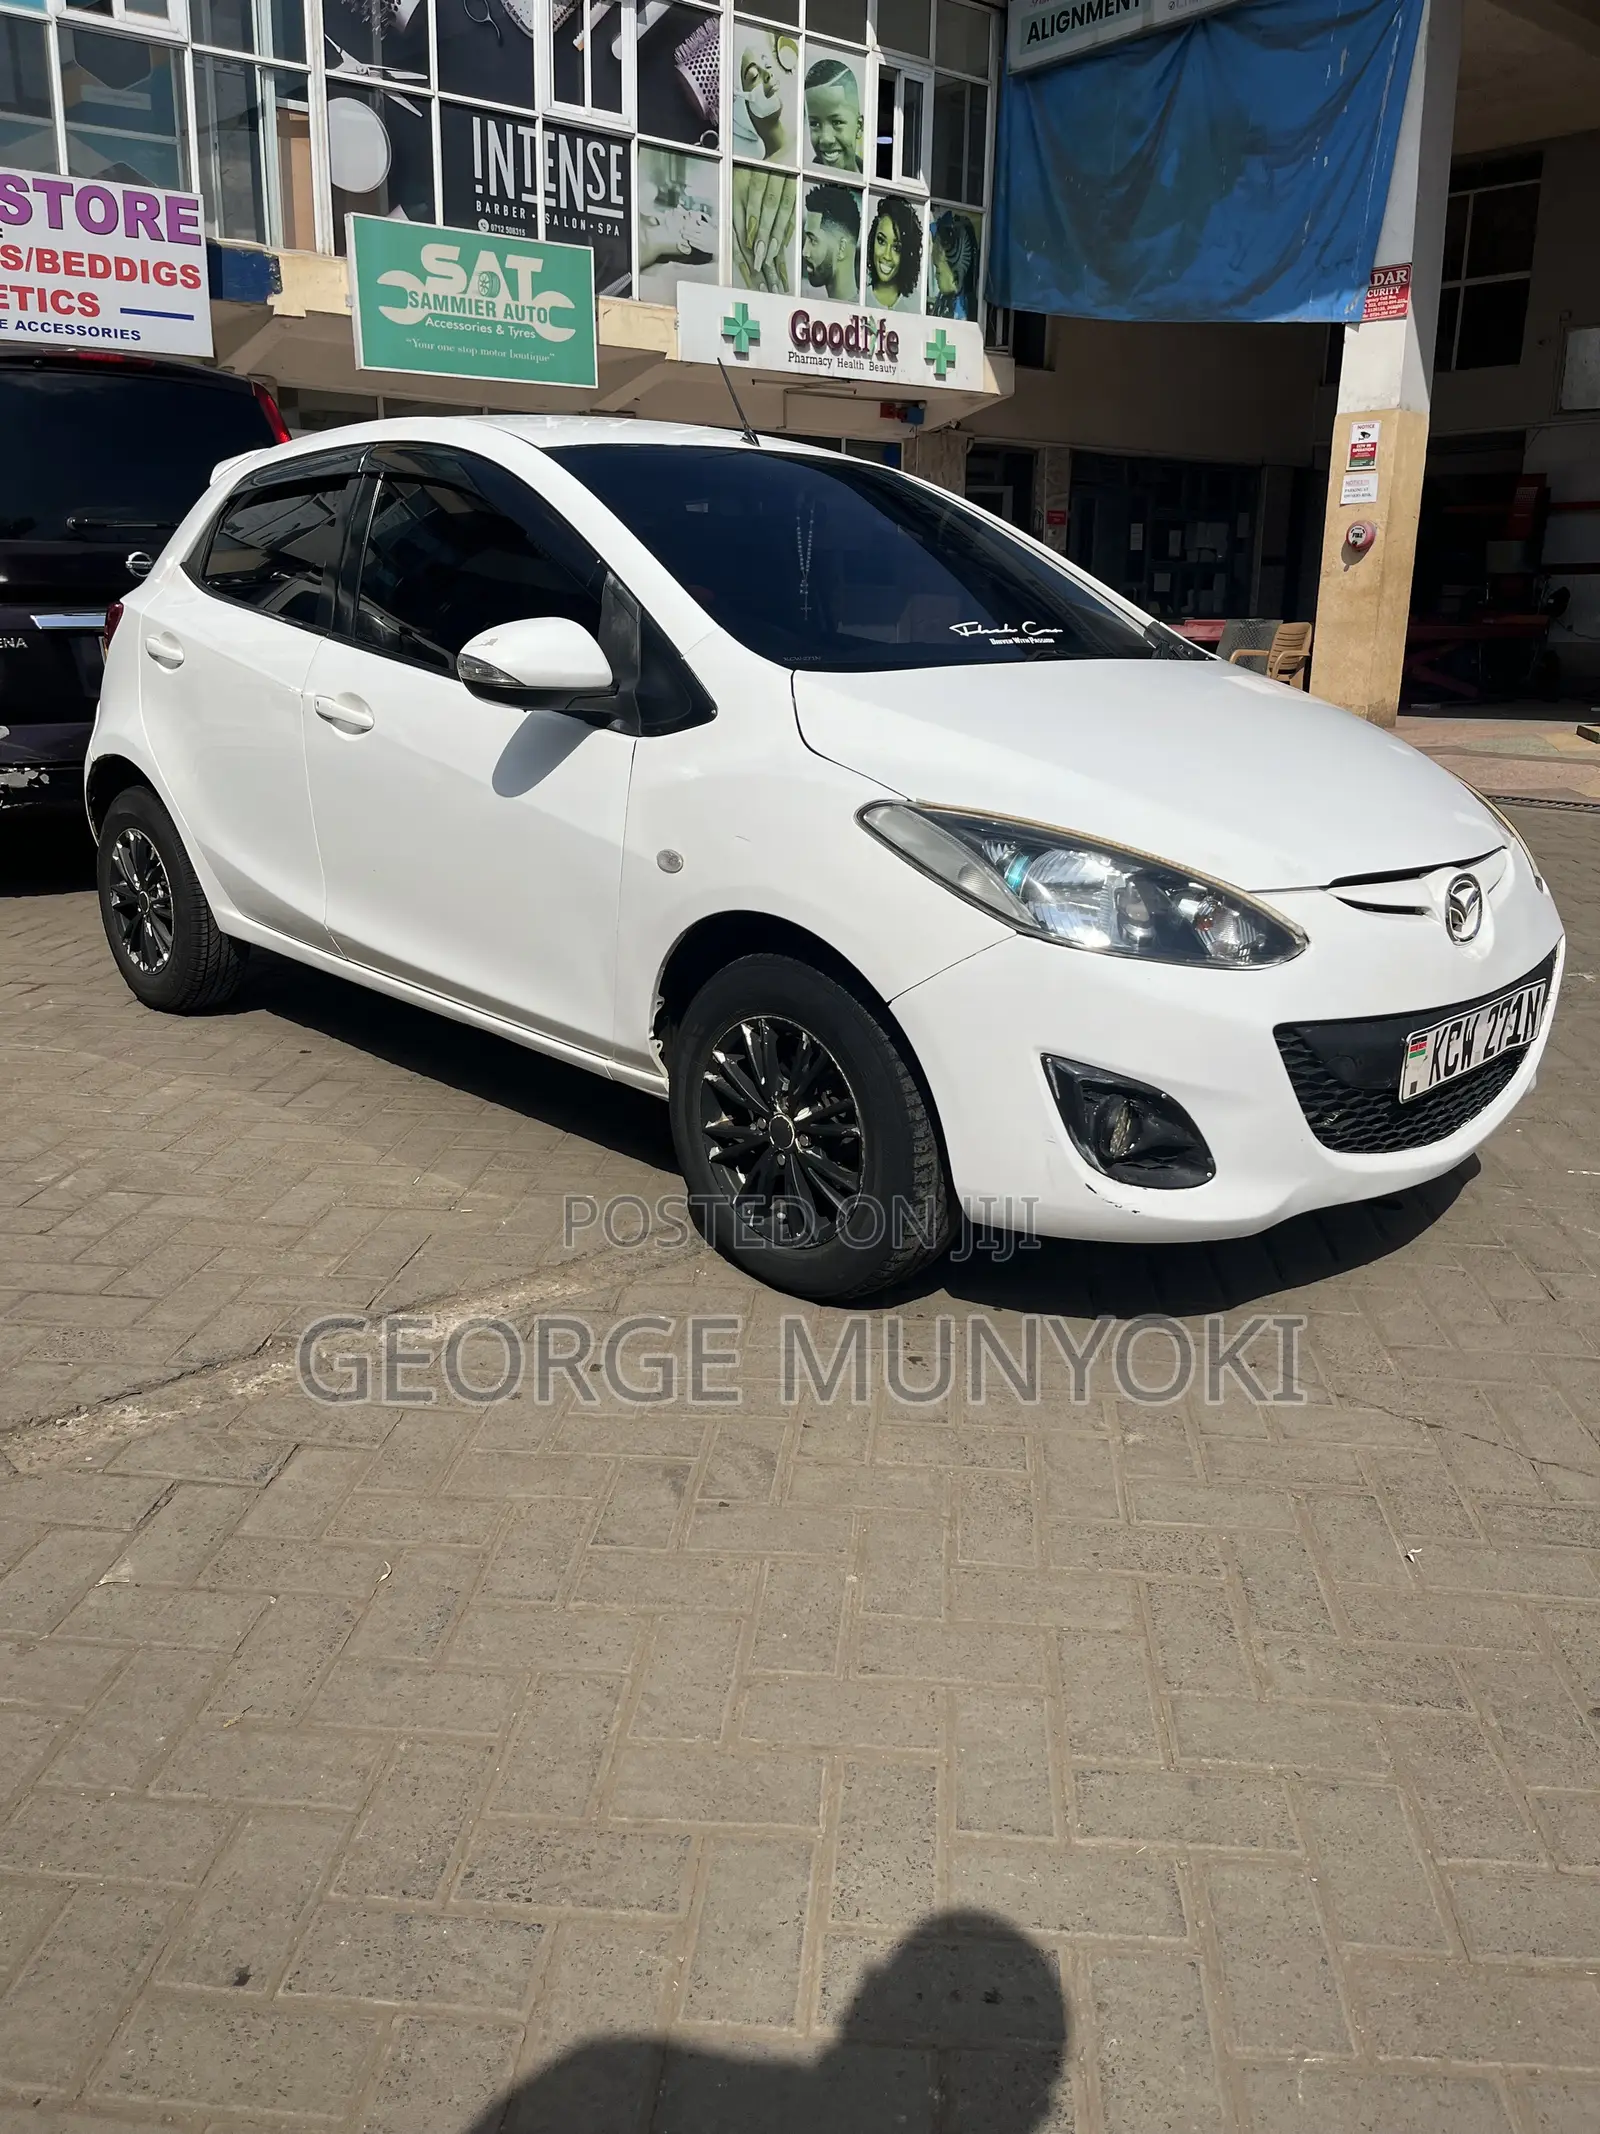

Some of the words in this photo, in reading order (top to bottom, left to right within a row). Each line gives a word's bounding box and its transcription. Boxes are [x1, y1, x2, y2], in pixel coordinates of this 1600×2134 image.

[0, 173, 201, 246] STORE
[476, 200, 526, 220] BARBER
[545, 212, 586, 230] SALON
[598, 222, 620, 236] SPA
[409, 291, 496, 318] SAMMIER
[503, 305, 548, 324] AUTO
[15, 320, 141, 341] ACCESSORIES
[425, 317, 493, 334] Accessories
[496, 324, 505, 335] &
[508, 326, 536, 339] Tyres
[437, 344, 455, 352] one
[457, 345, 478, 357] stop
[480, 349, 506, 358] motor
[788, 351, 833, 369] Pharmacy
[837, 358, 865, 371] Health
[869, 361, 897, 376] Beauty
[1429, 1013, 1481, 1086] KCW
[1483, 987, 1541, 1060] 271N
